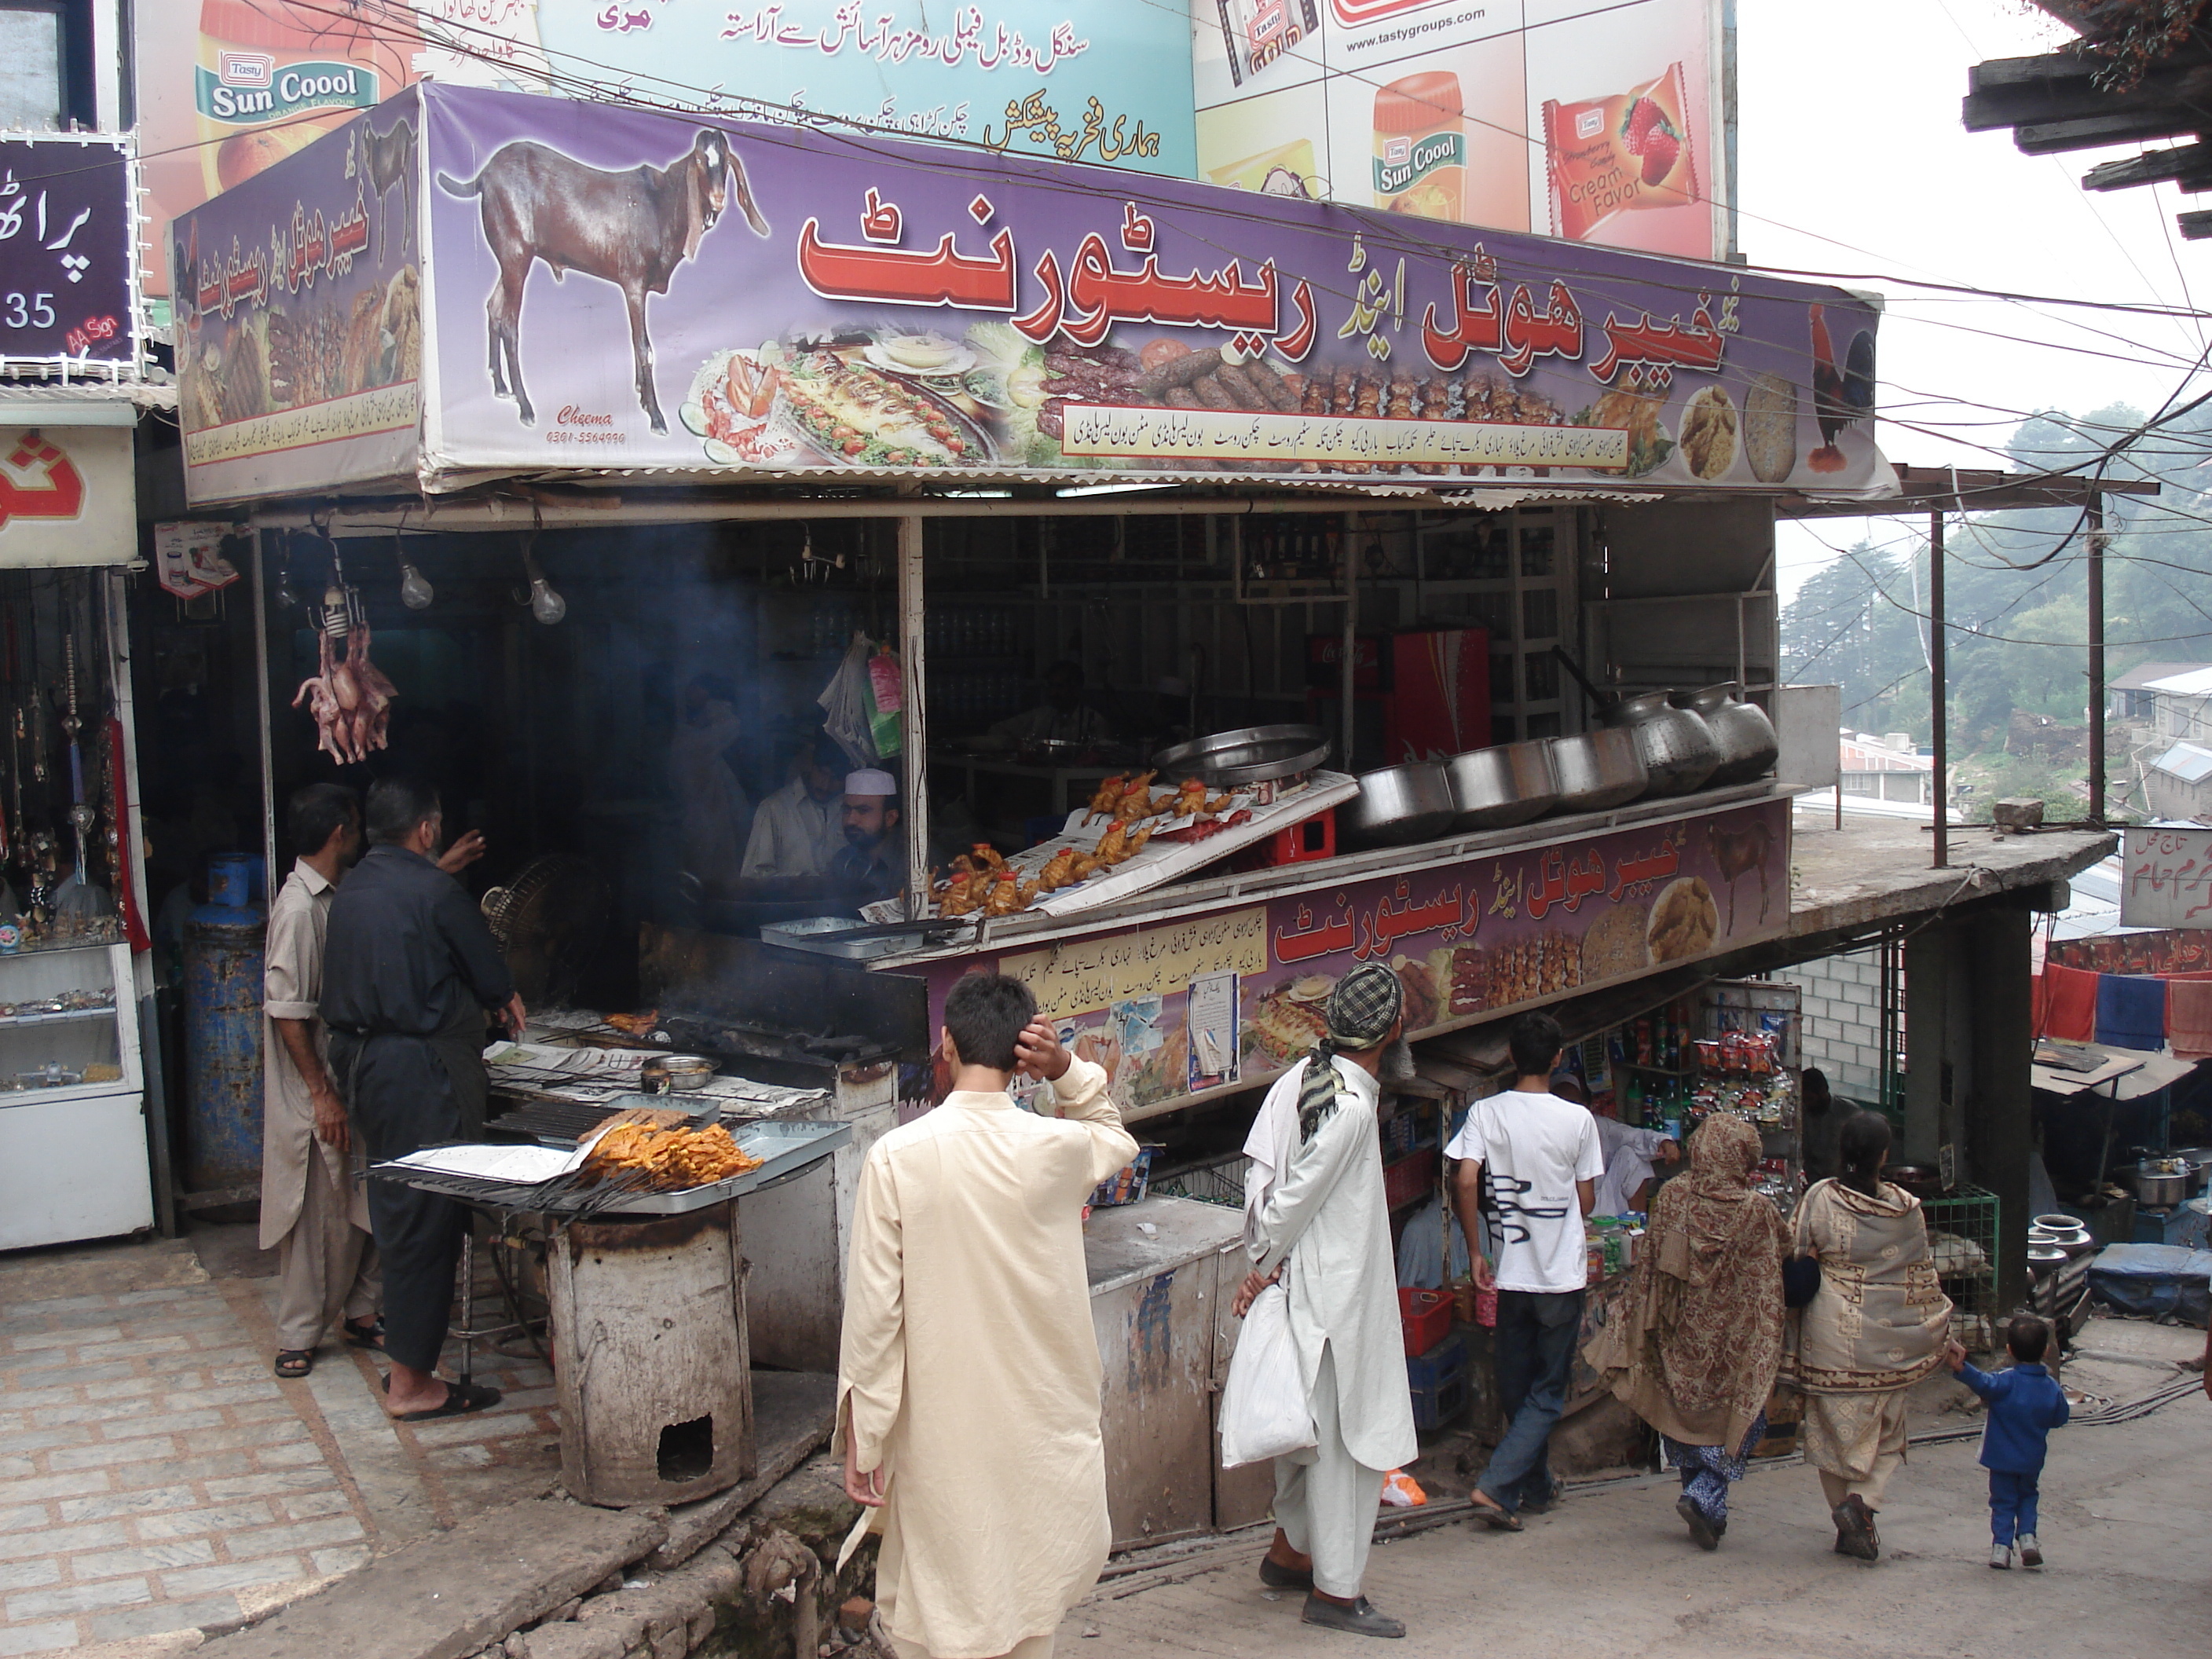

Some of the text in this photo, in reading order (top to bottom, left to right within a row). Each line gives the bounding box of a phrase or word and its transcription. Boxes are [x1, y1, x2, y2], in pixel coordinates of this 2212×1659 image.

[598, 5, 651, 32] مری
[720, 6, 782, 40] آراستہ
[776, 25, 816, 45] سے
[821, 2, 892, 53] آسائش
[943, 6, 982, 64] فیملی
[1257, 13, 1281, 38] Tasty
[1346, 9, 1485, 52] www.tastygroups.com
[1035, 23, 1089, 72] سنگل
[232, 64, 262, 76] Tasty
[213, 70, 357, 117] Sun Coool
[938, 103, 968, 137] چکن
[984, 89, 1159, 163] ہماری فخریہ پیشکش
[1381, 165, 1412, 191] Sun
[1415, 135, 1456, 172] Coool
[1569, 167, 1623, 203] Cream
[1593, 178, 1640, 216] Favor
[797, 185, 1320, 364] ریسٹورنٹ
[5, 293, 56, 328] 35
[1337, 230, 1405, 361] اینڈ
[1718, 275, 1740, 333] نیو
[68, 329, 90, 353] AA
[86, 318, 117, 339] Sign
[1588, 286, 1726, 385] خیبر
[557, 405, 613, 425] Cheema
[1241, 417, 1260, 449] چکن
[1326, 420, 1343, 452] چکن
[1423, 426, 1437, 456] حلیم
[1485, 434, 1503, 457] نہاری
[1521, 431, 1535, 458] مرغ
[1610, 433, 1623, 459] چکن
[2136, 831, 2160, 855] محل
[2160, 835, 2188, 855] تاج
[1609, 826, 1680, 903] خیبر
[2132, 861, 2173, 897] حمام
[1488, 862, 1524, 919] اینڈ
[1248, 912, 1262, 937] چکن
[1274, 875, 1481, 965] ریسٹورنٹ
[1111, 947, 1132, 967] نہاری
[1150, 936, 1166, 959] مرغ
